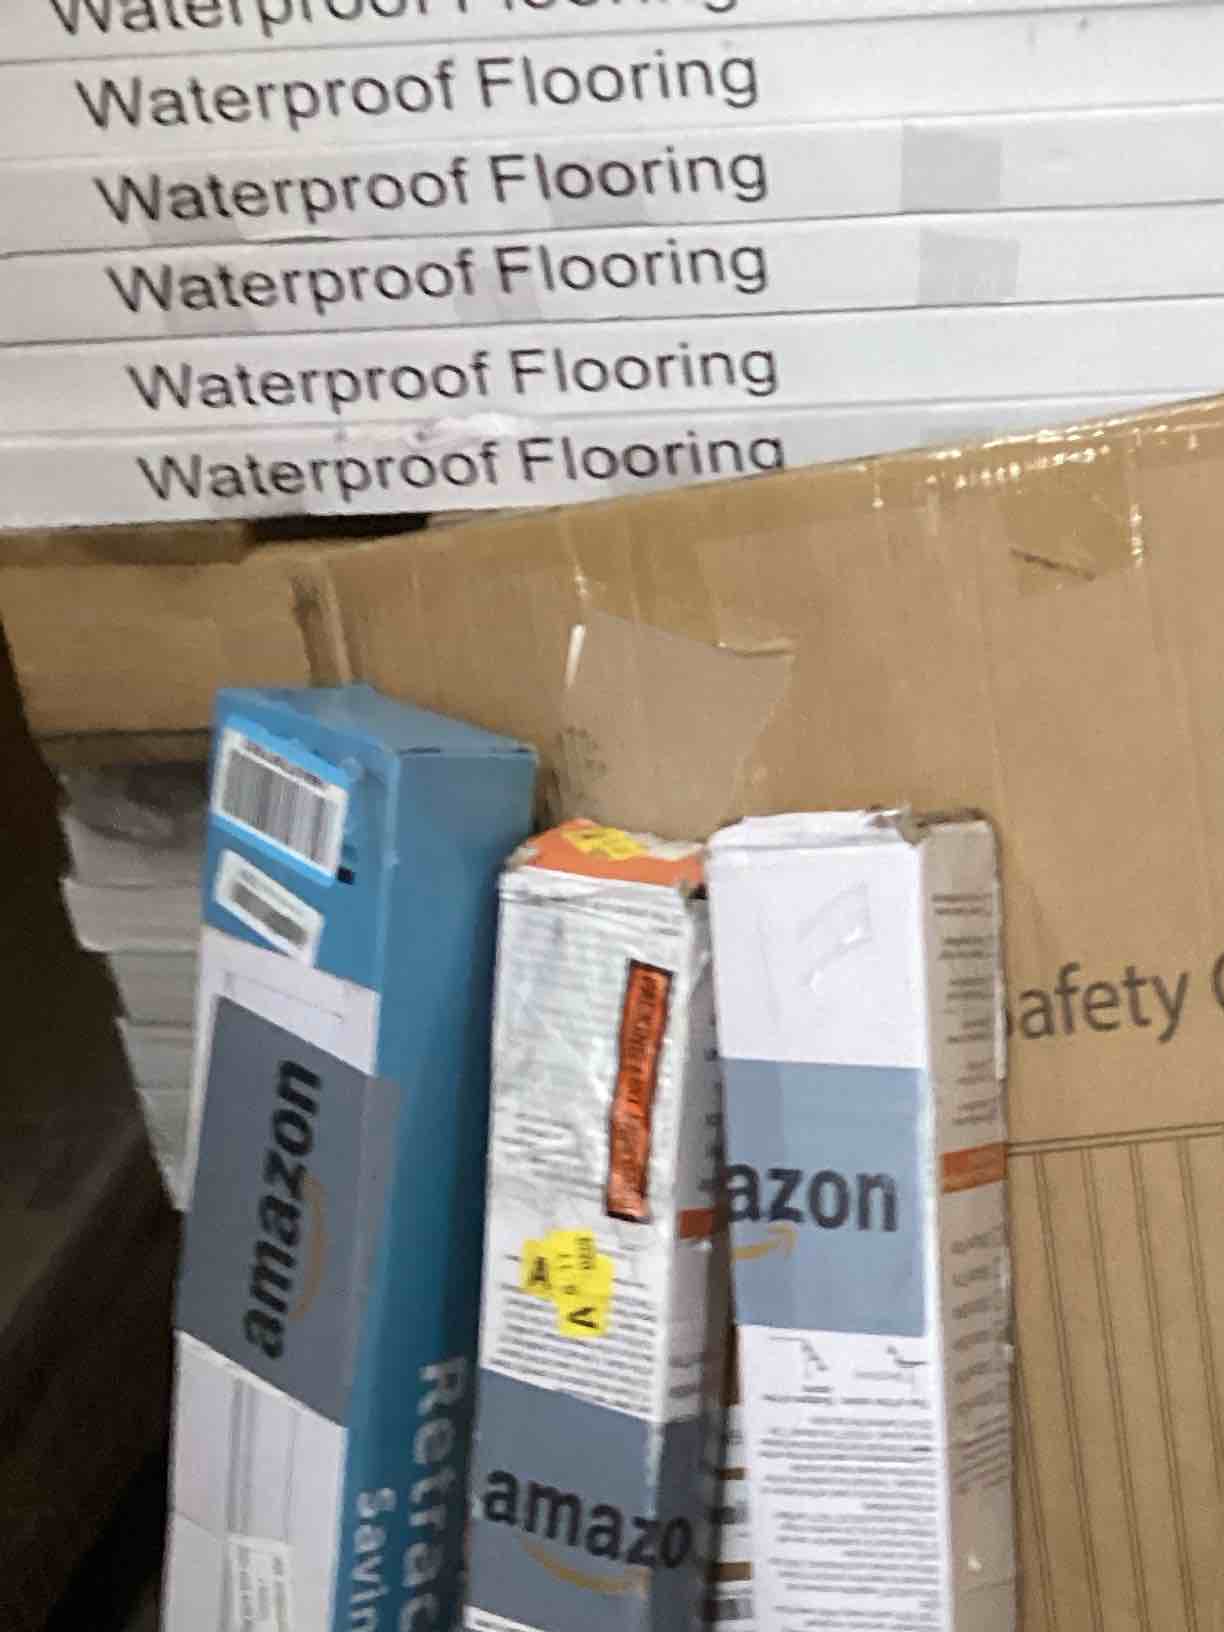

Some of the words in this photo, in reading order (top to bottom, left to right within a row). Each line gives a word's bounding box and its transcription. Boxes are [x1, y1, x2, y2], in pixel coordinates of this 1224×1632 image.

[75, 59, 455, 132] Waterproof
[477, 48, 758, 108] Flooring
[93, 156, 470, 225] Waterproof
[488, 145, 768, 202] Flooring
[105, 246, 473, 314] Waterproof
[496, 240, 769, 296] Flooring
[126, 351, 489, 414] Waterproof
[510, 342, 778, 397] Flooring
[138, 441, 499, 502] Waterproof
[1006, 961, 1188, 1045] afety
[243, 1060, 322, 1359] amazon
[725, 1163, 898, 1232] azon
[483, 1468, 694, 1570] amazo
